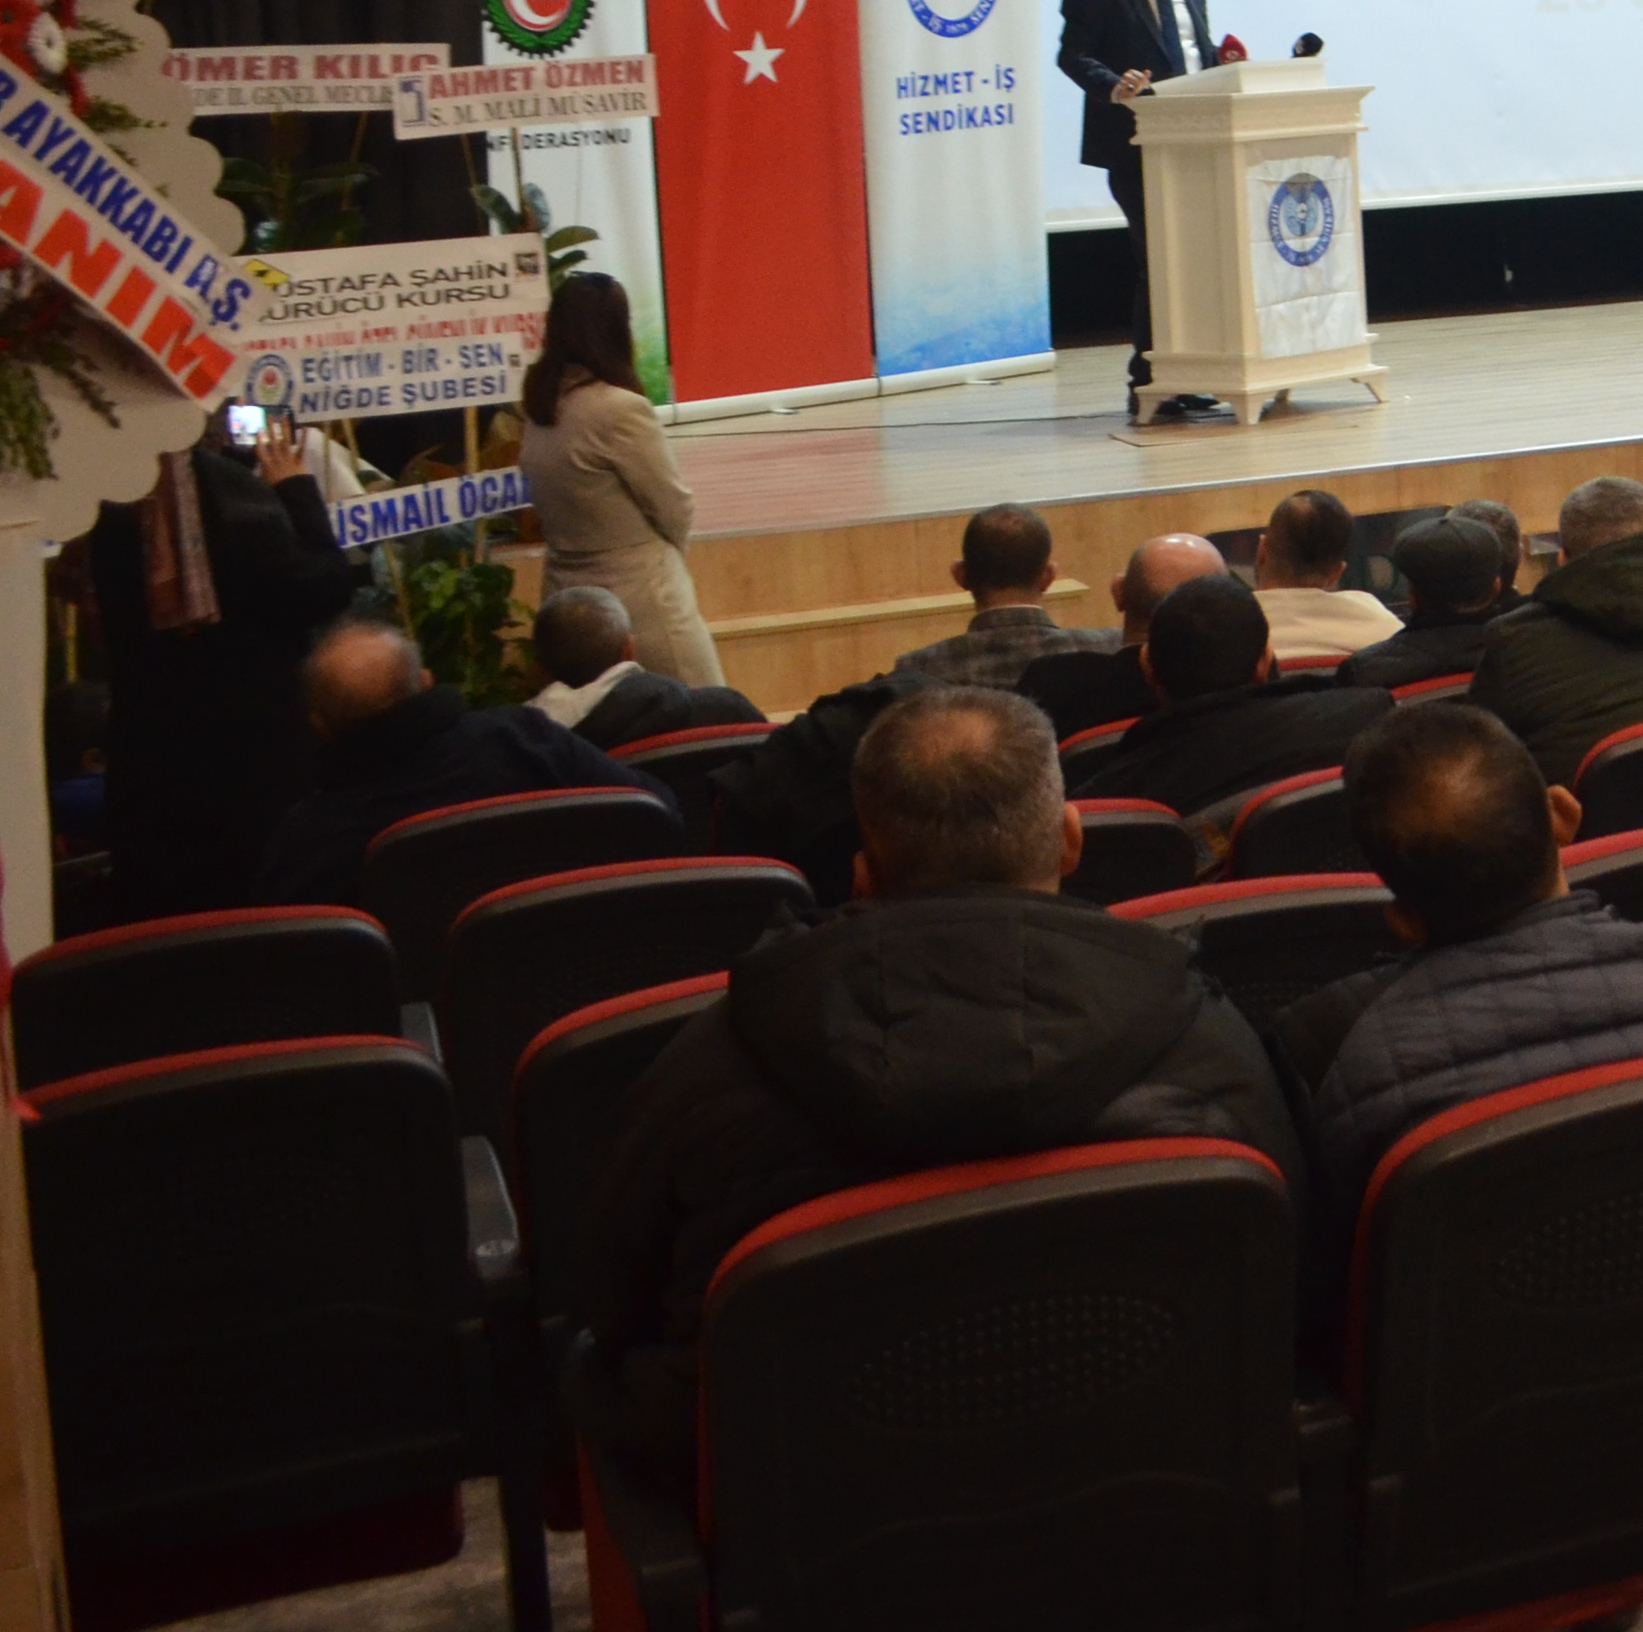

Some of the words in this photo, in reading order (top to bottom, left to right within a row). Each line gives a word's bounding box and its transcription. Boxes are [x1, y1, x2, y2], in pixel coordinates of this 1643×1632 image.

[428, 66, 535, 100] AHMET
[544, 60, 644, 90] ÖZMEN
[896, 70, 975, 100] HİZMET
[995, 64, 1016, 93] İŞ
[899, 102, 1015, 136] SENDİKASI
[2, 99, 194, 274] AYAKKABI
[273, 271, 402, 299] USTAFA
[409, 259, 509, 289] ŞAHİN
[258, 293, 386, 322] ÜRÜCÜ
[396, 283, 511, 309] KURSU
[301, 348, 383, 384] EĞİTİM
[401, 344, 440, 375] BİR
[457, 342, 504, 367] SEN
[299, 381, 393, 415] NİĞDE
[401, 373, 508, 410] ŞUBESİ
[336, 482, 451, 547] İSMAİL
